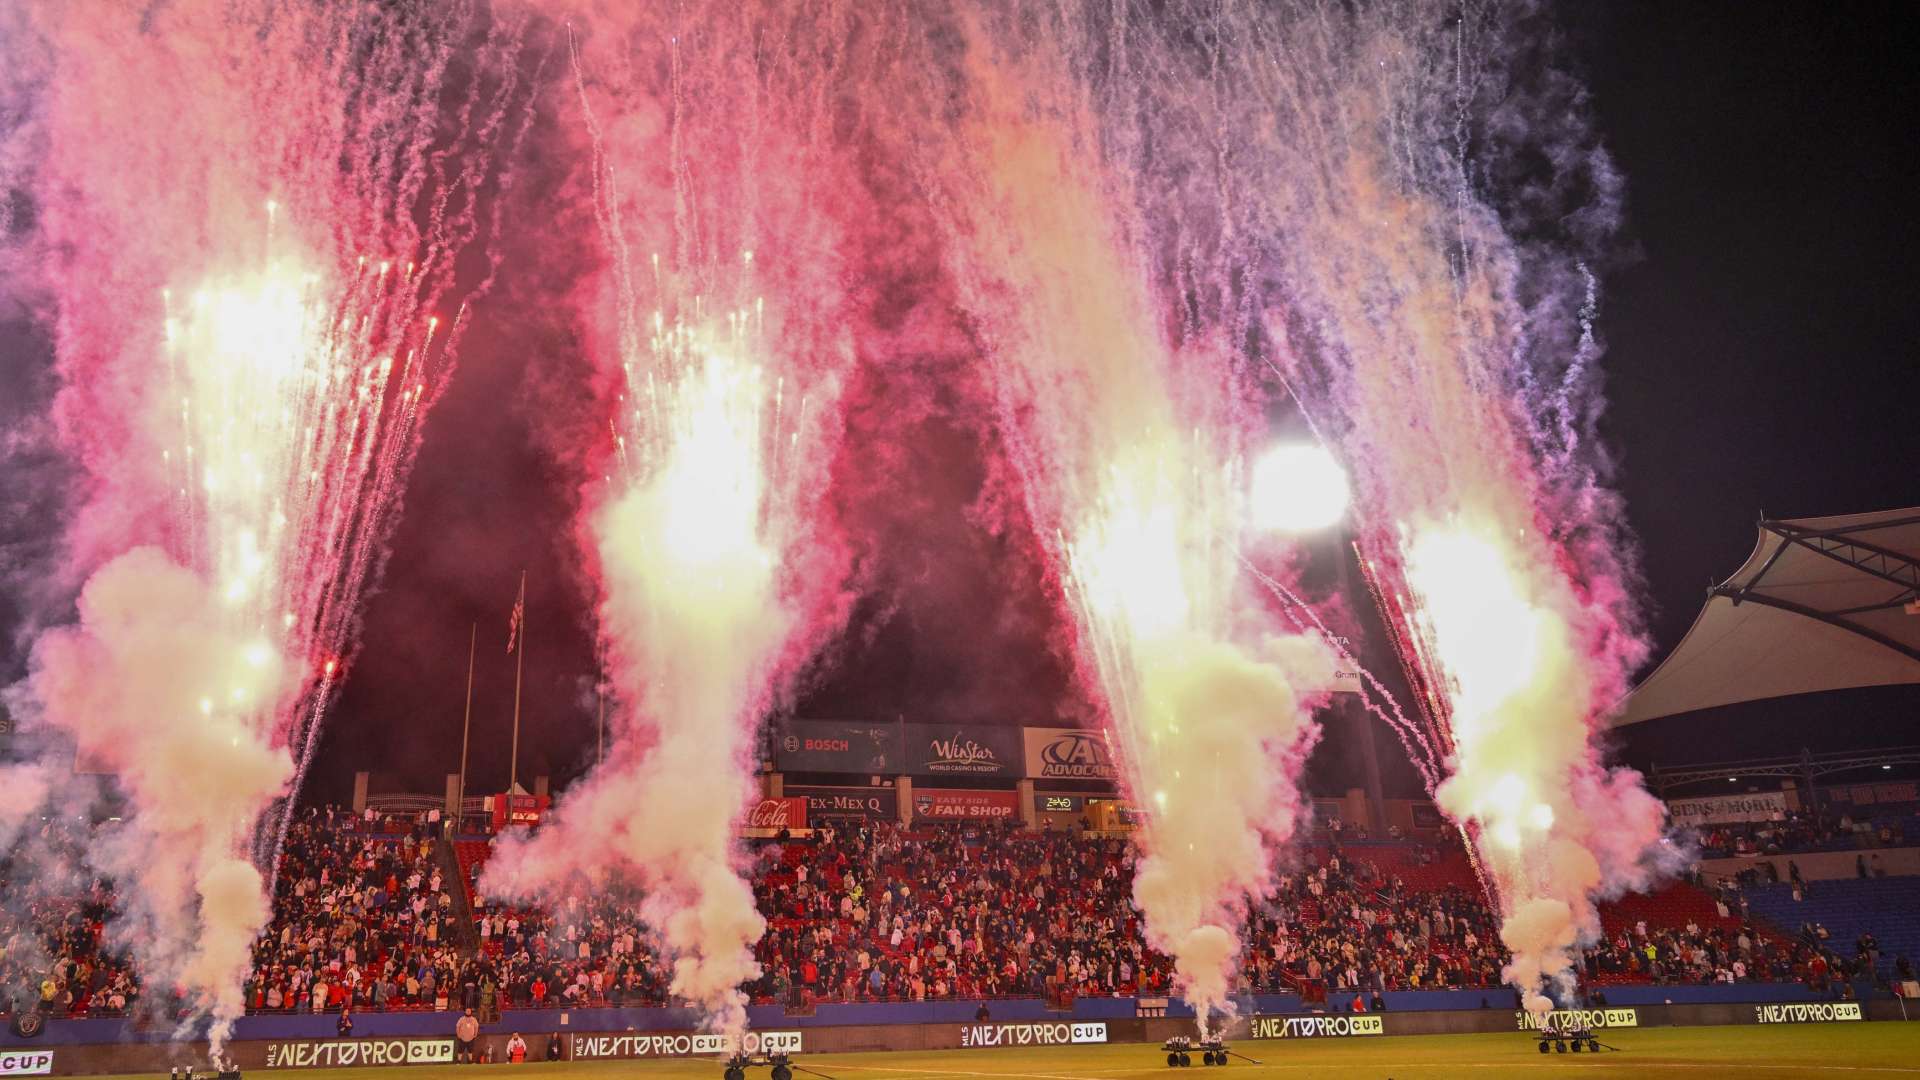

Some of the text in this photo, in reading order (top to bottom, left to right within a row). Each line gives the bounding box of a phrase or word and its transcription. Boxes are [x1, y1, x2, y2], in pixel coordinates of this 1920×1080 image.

[805, 739, 849, 752] BOSCH
[929, 731, 996, 765] WinStar
[1042, 763, 1120, 777] ADVOCAR
[868, 798, 883, 813] Q
[935, 805, 1012, 816] FAN SHOP
[1607, 1013, 1634, 1022] CUP
[1836, 1007, 1858, 1016] CUP
[961, 1026, 969, 1046] MLS
[1073, 1027, 1104, 1037] CUP
[1250, 1020, 1259, 1038] MLS
[1352, 1020, 1379, 1030] CUP
[575, 1038, 583, 1056] MLS
[696, 1038, 728, 1048] CUP
[764, 1036, 799, 1047] CUP
[3, 1056, 49, 1069] CUP
[267, 1044, 277, 1067] MLS
[411, 1045, 450, 1057] CUP
